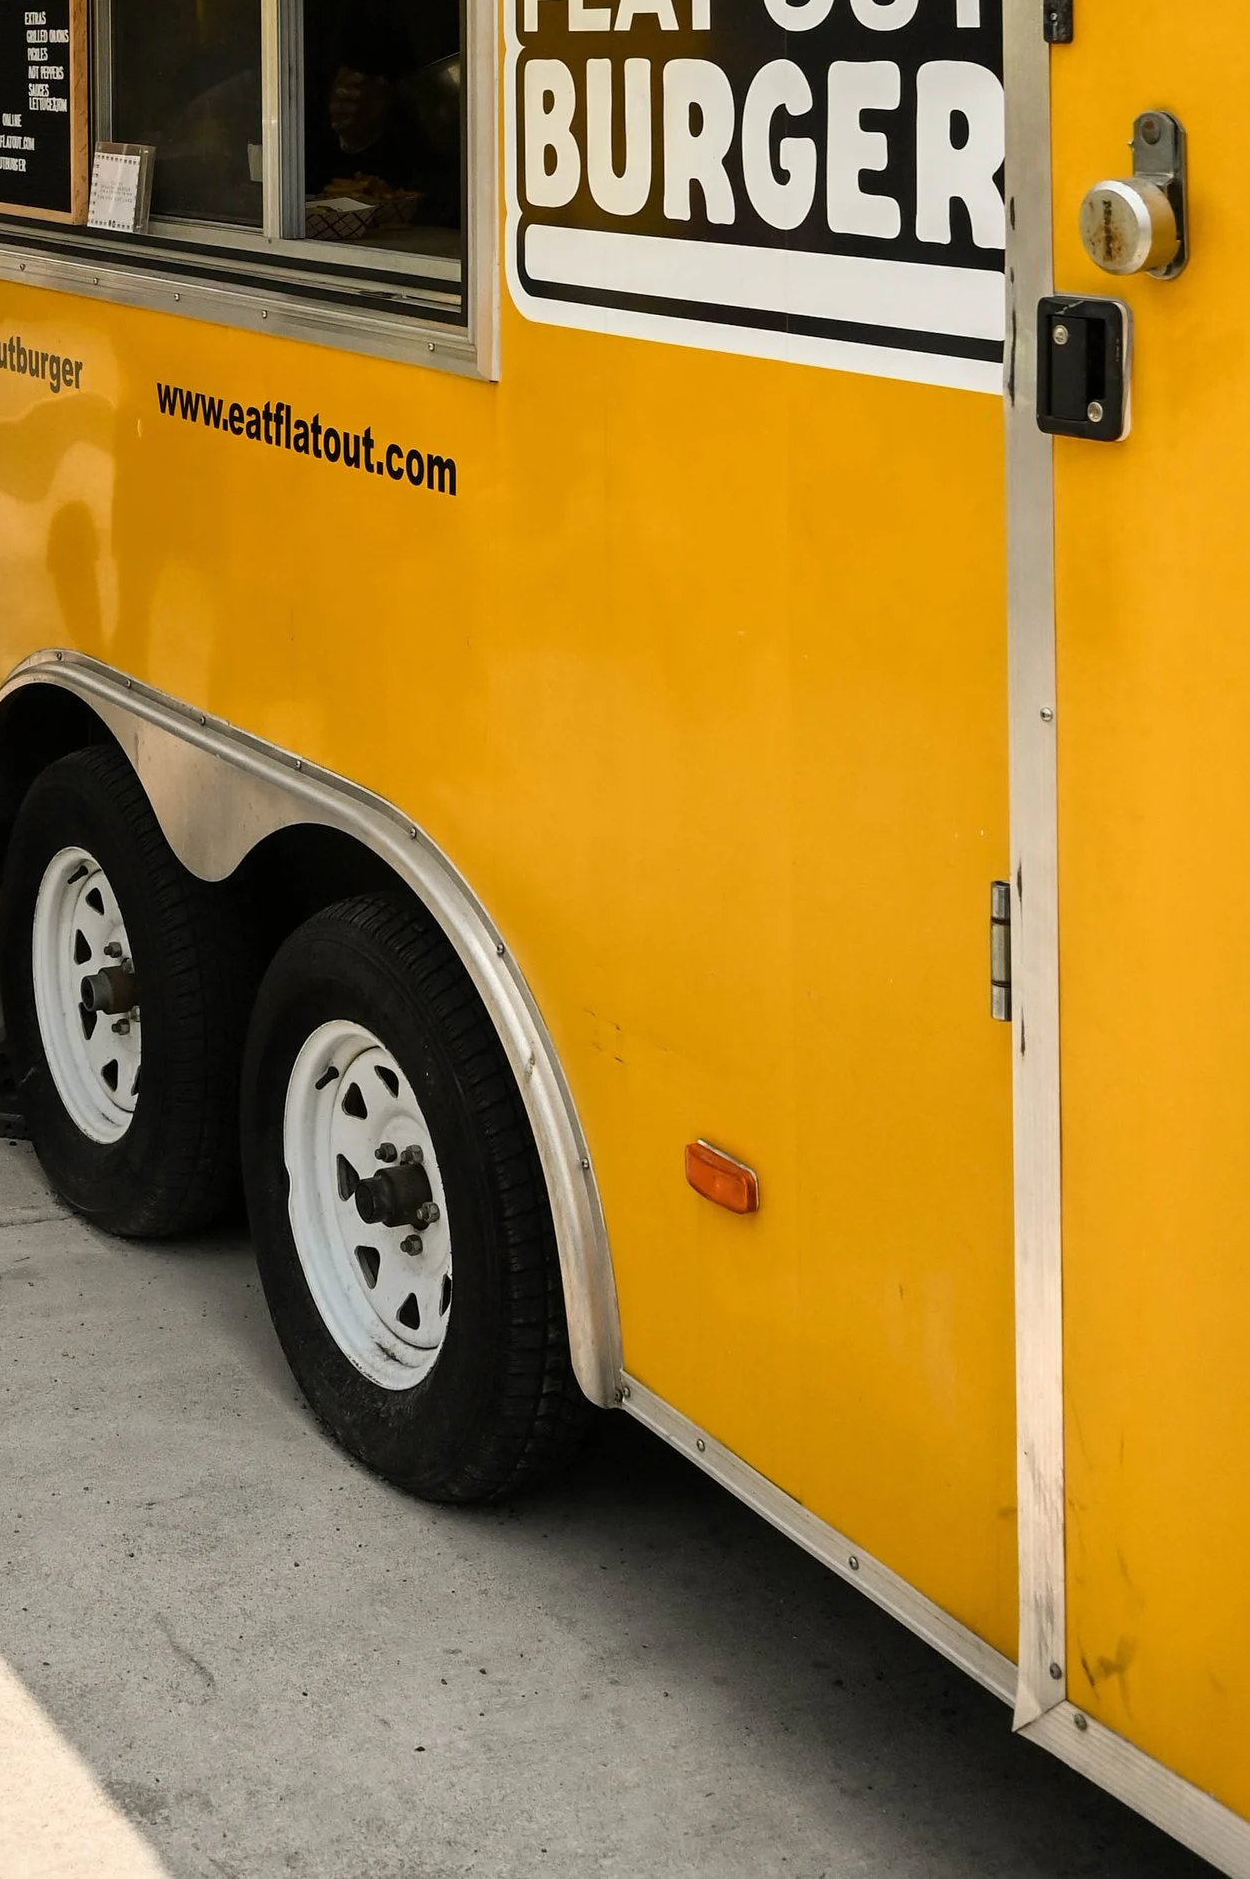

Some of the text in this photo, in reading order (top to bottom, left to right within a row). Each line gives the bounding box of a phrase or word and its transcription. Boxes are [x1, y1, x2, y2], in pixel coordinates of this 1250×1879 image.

[25, 11, 46, 25] EXTRAS
[26, 30, 69, 43] GRILLED ONIONS
[27, 47, 48, 61] PICKLES
[40, 66, 64, 79] PEPPERS
[28, 83, 49, 97] SAUCES
[2, 113, 22, 127] ONLINE
[523, 58, 1006, 249] BURGER
[156, 382, 457, 496] www.eatflatout.com
